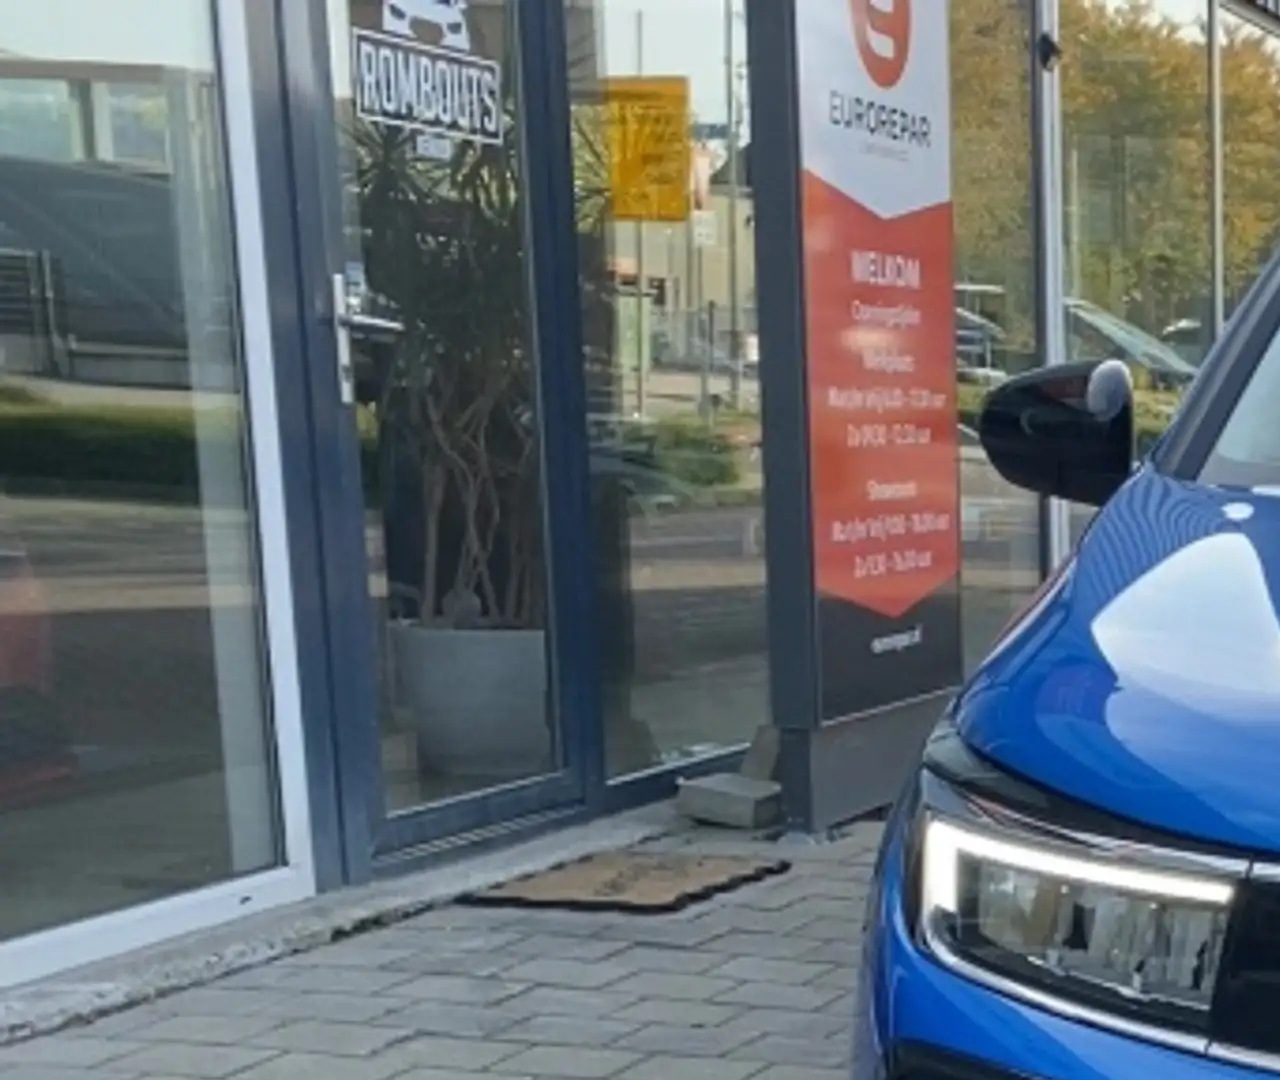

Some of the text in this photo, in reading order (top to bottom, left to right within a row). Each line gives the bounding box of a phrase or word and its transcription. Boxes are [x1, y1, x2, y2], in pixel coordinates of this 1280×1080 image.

[360, 41, 497, 132] ROMBOUTS
[829, 90, 931, 148] EUROREPAR
[851, 250, 921, 289] WELKOM
